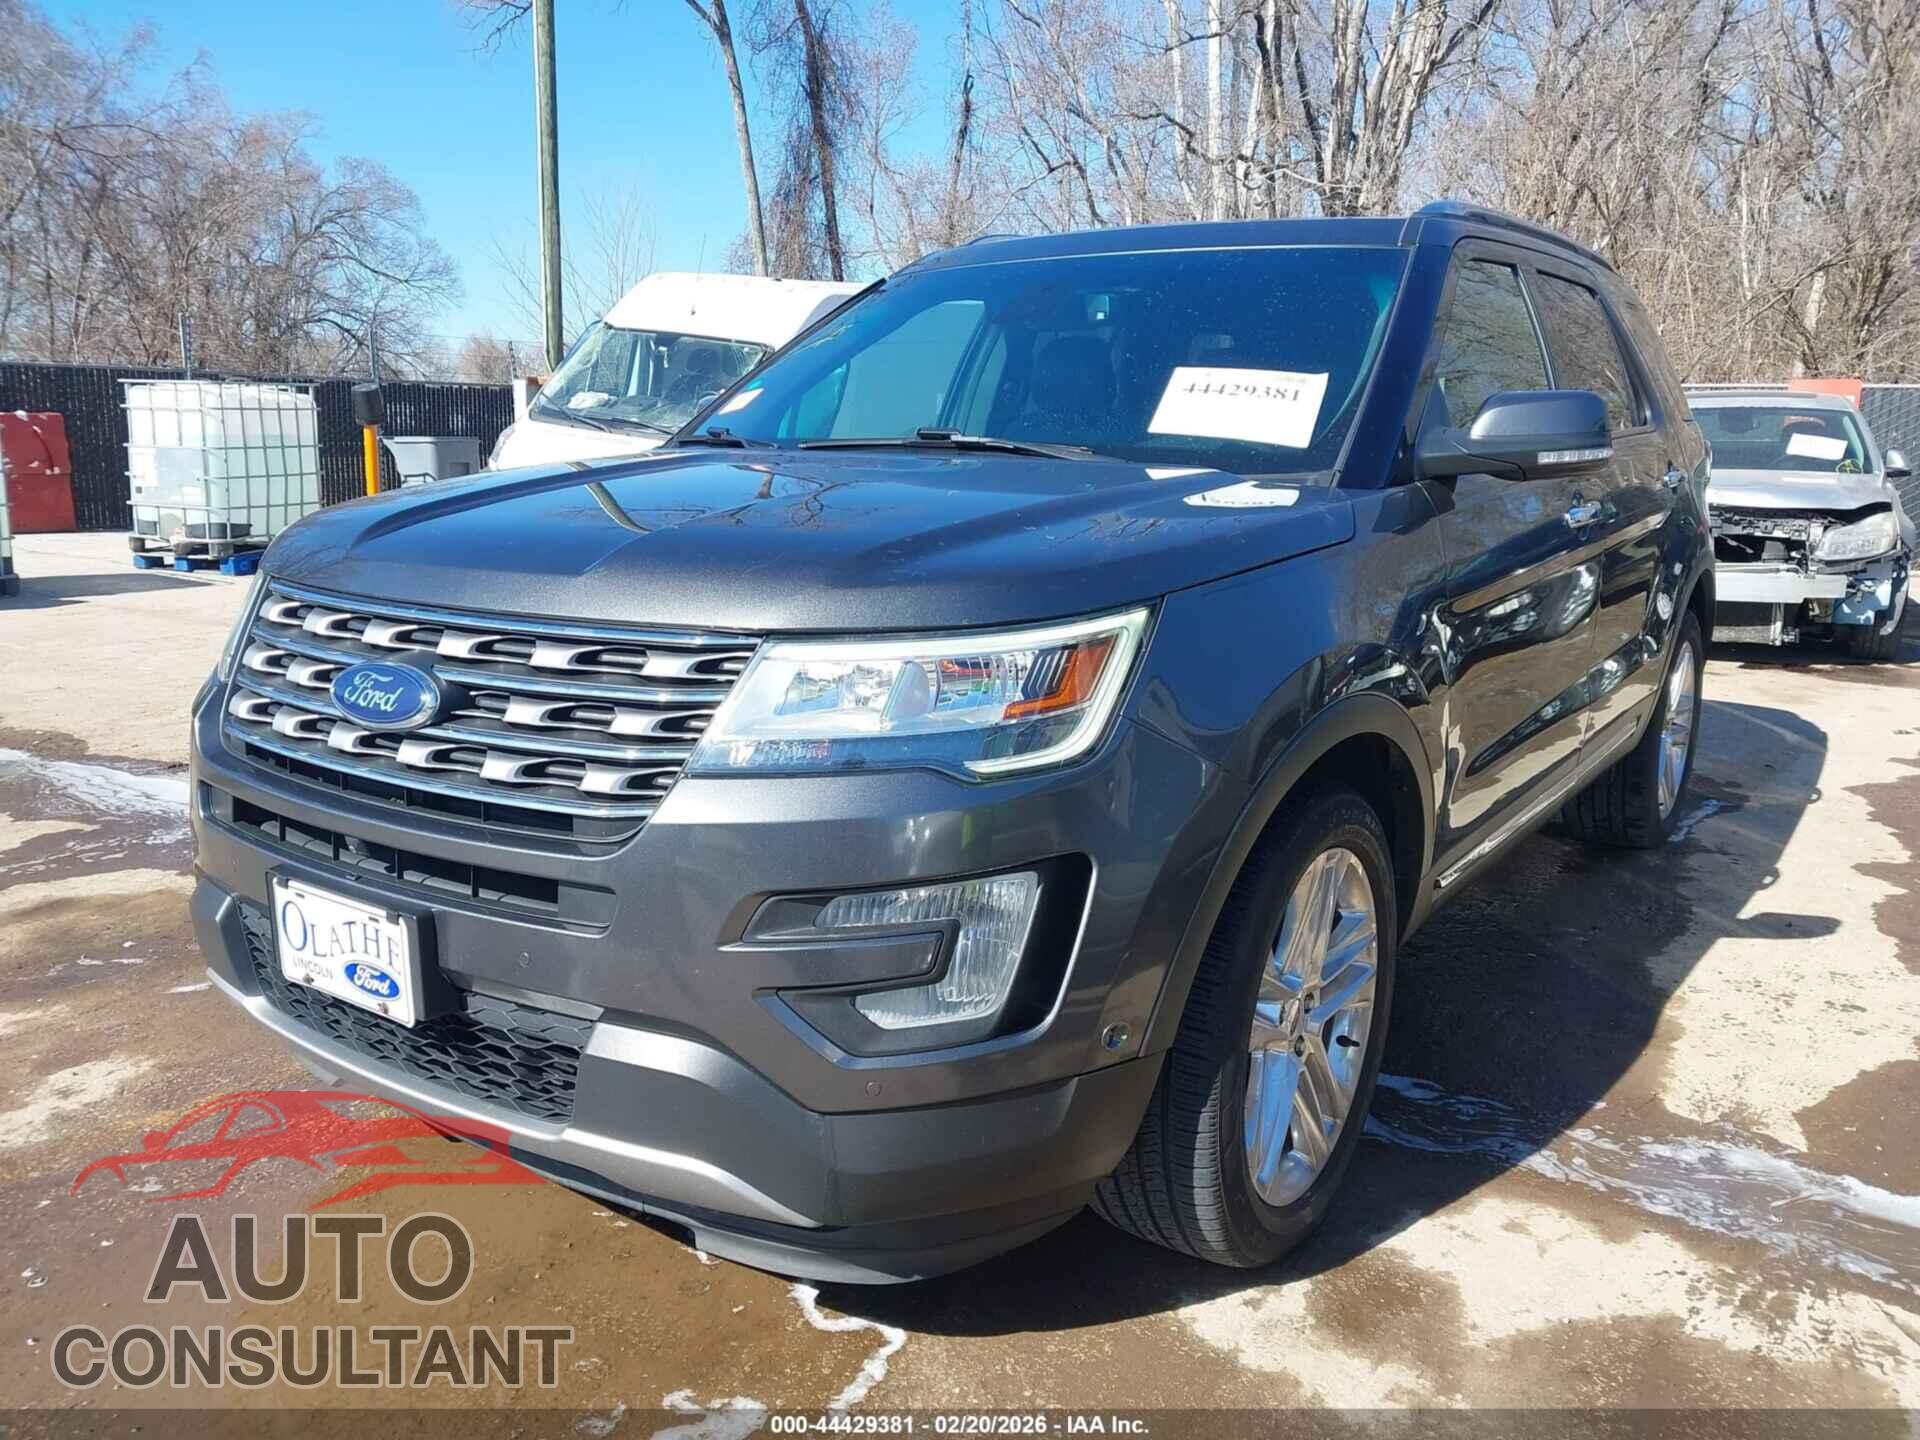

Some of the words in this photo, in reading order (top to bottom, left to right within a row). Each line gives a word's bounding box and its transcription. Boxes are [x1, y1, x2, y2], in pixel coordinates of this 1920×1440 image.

[1183, 382, 1301, 402] 44429381
[343, 670, 404, 712] Ford
[292, 956, 334, 980] LINCOLN
[353, 965, 391, 995] Ford
